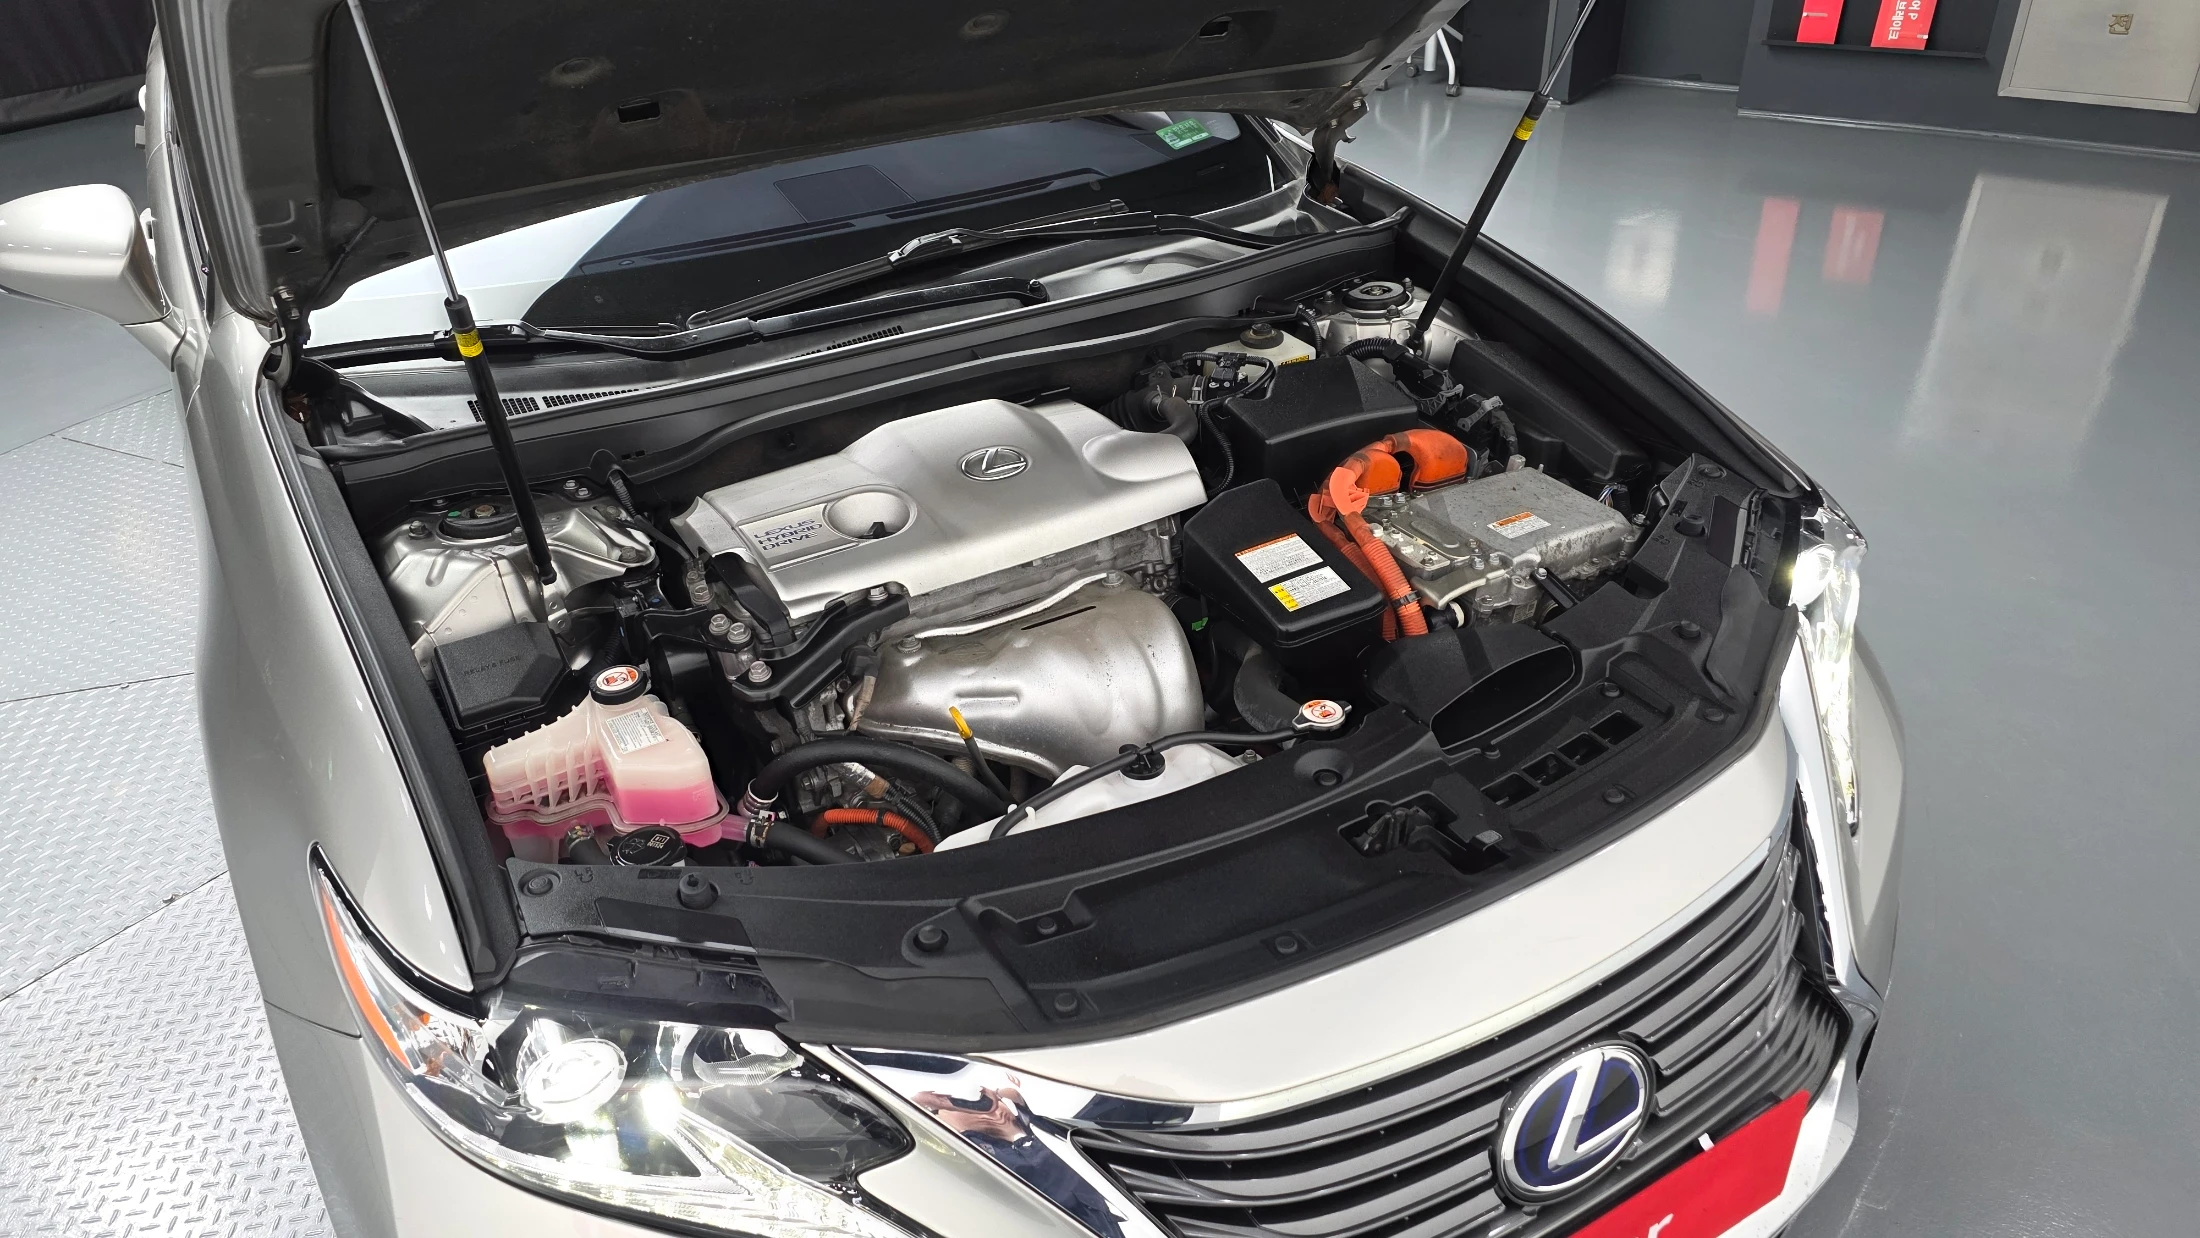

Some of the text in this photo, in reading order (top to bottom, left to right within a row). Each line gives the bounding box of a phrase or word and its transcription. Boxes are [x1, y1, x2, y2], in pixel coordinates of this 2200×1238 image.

[2109, 13, 2134, 35] 전
[754, 519, 815, 538] LEXUS
[758, 524, 823, 545] HYBRID
[762, 532, 818, 551] DRIVE
